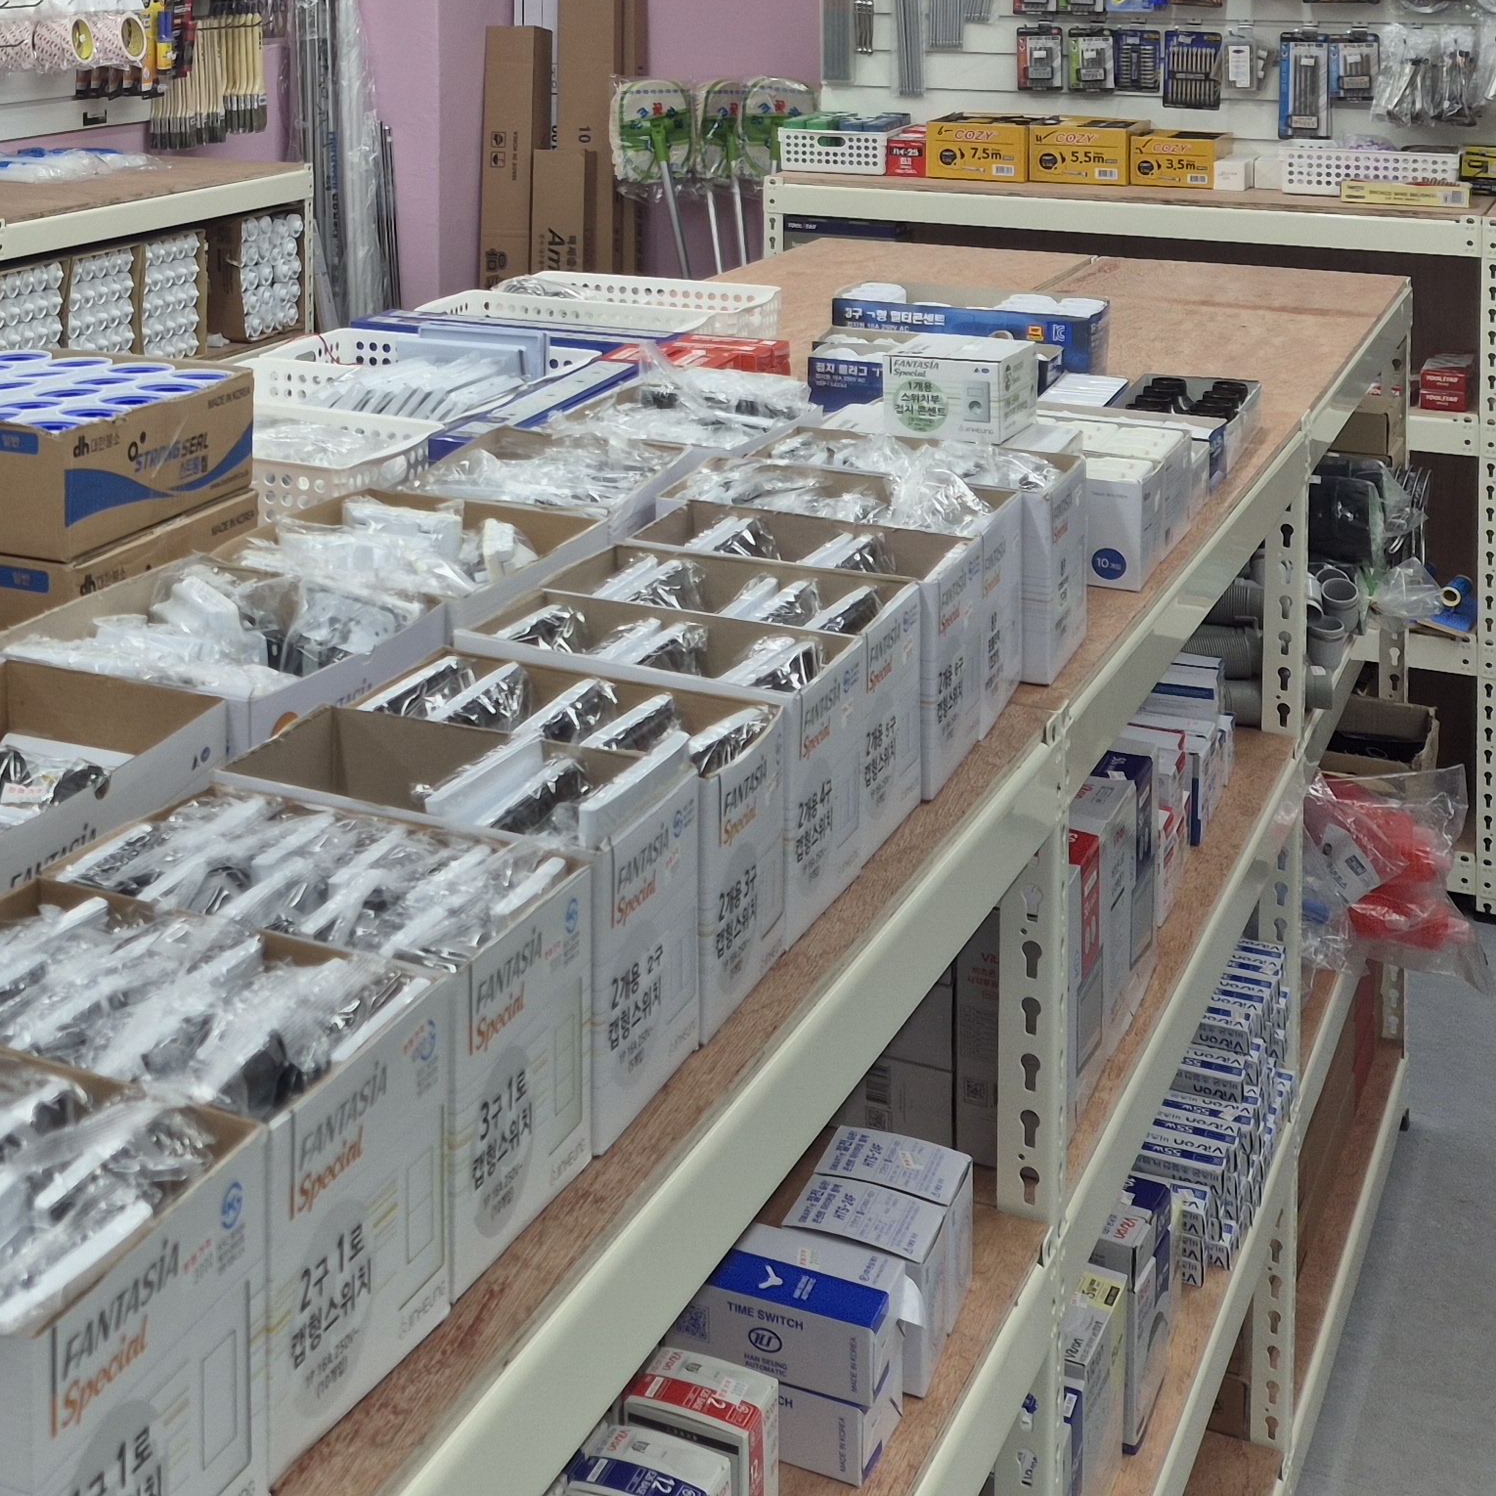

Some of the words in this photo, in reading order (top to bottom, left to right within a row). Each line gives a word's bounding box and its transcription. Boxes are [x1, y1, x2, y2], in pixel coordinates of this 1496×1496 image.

[954, 129, 995, 141] COZY
[1055, 133, 1095, 144] COZY
[970, 147, 1002, 161] 7.5m
[1152, 142, 1188, 154] COZY
[1070, 151, 1105, 164] 5.5m
[1165, 158, 1196, 171] 3.5m
[893, 367, 926, 378] Special
[906, 381, 933, 393] 1개용
[900, 392, 941, 404] 스위치부
[802, 720, 831, 760] Special
[722, 805, 757, 847] Special
[616, 870, 657, 927] Special
[475, 981, 525, 1052] Special
[1199, 1033, 1243, 1051] Vitron
[1193, 1084, 1238, 1104] Vitron
[1185, 1116, 1235, 1134] Vitron
[471, 1100, 533, 1191] 캡형스위치
[1173, 1138, 1223, 1155] Vitron
[298, 1124, 364, 1215] Special
[290, 1256, 373, 1371] 캡형스위치
[726, 1300, 755, 1318] TIME
[756, 1309, 805, 1331] SWITCH
[61, 1313, 149, 1430] Special
